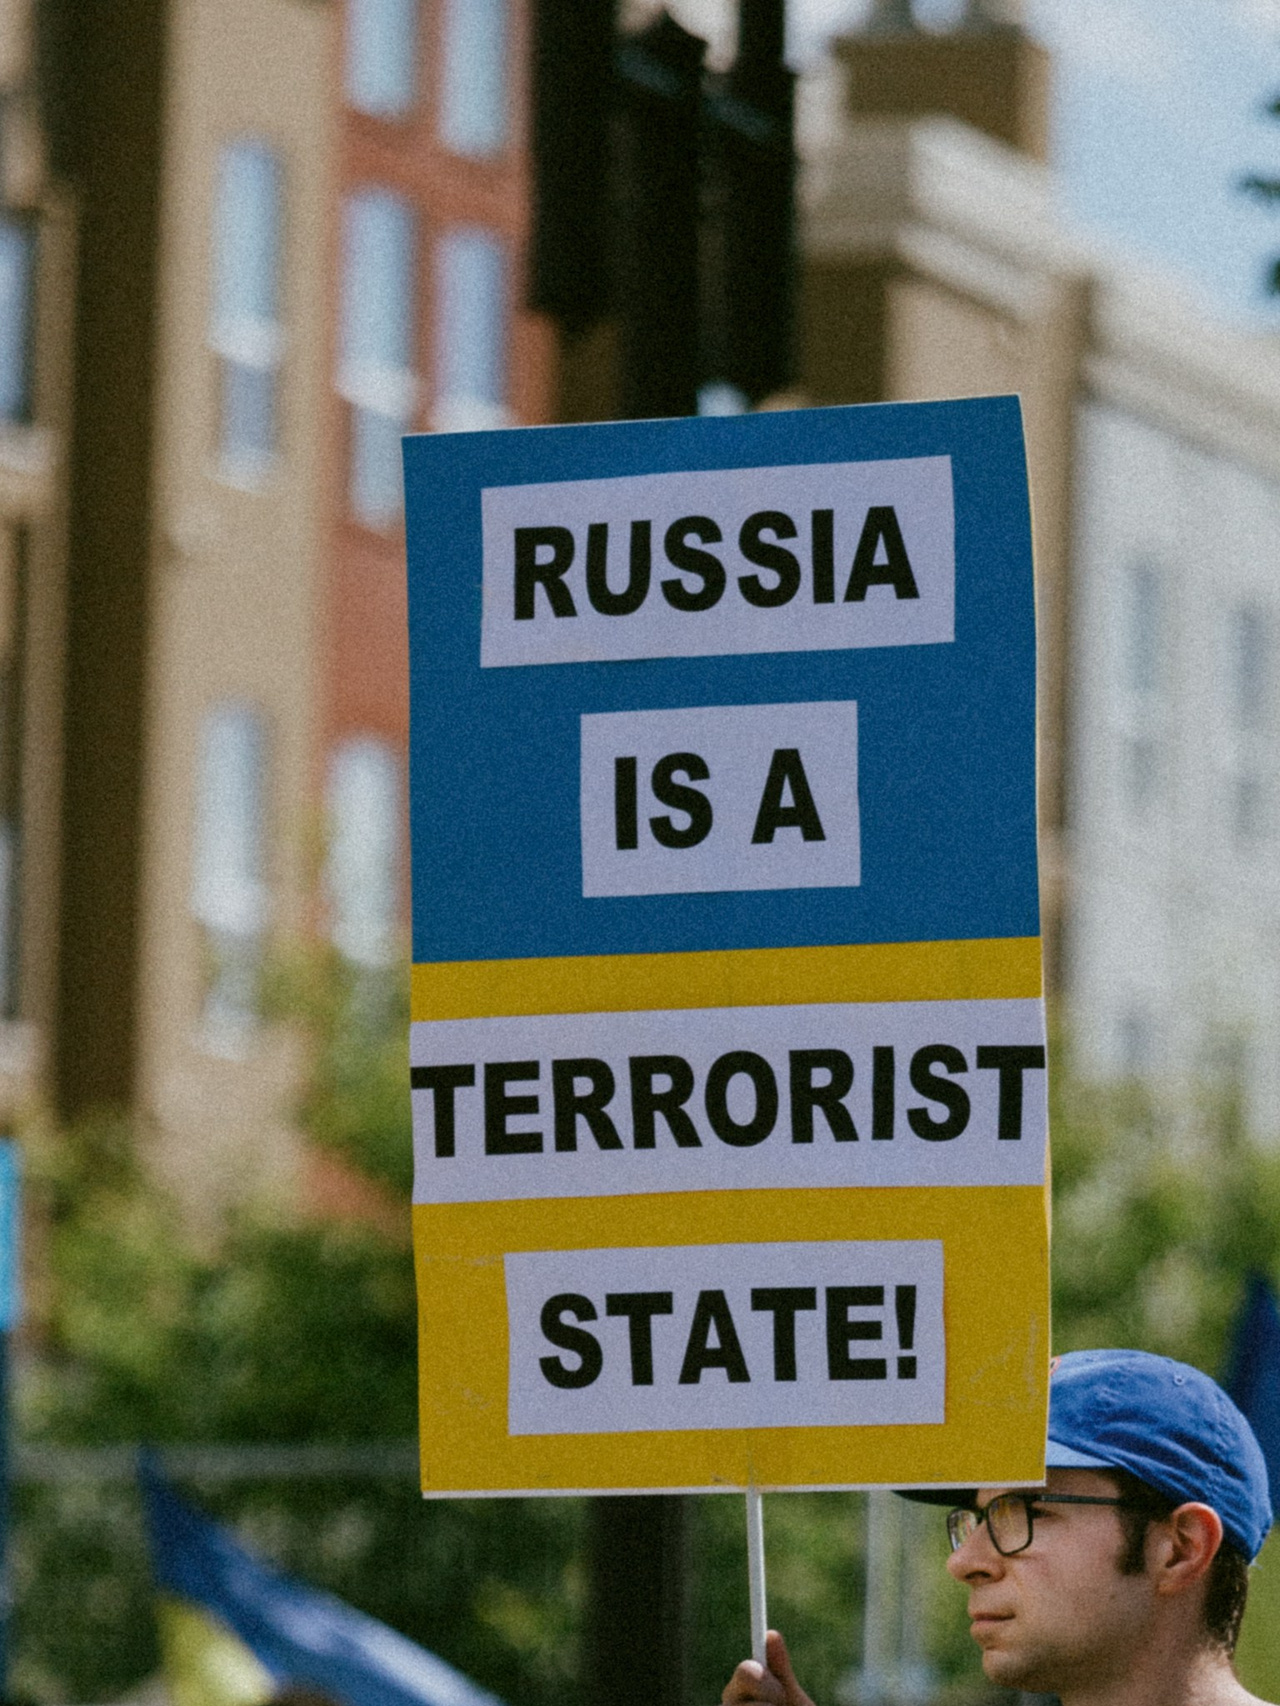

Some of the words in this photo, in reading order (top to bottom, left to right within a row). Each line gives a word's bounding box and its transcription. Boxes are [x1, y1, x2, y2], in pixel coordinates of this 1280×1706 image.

[513, 505, 919, 620] RUSSIA
[614, 752, 713, 850] IS
[750, 748, 826, 844] A
[410, 1043, 1046, 1158] TERRORIST
[538, 1284, 917, 1389] STATE!
